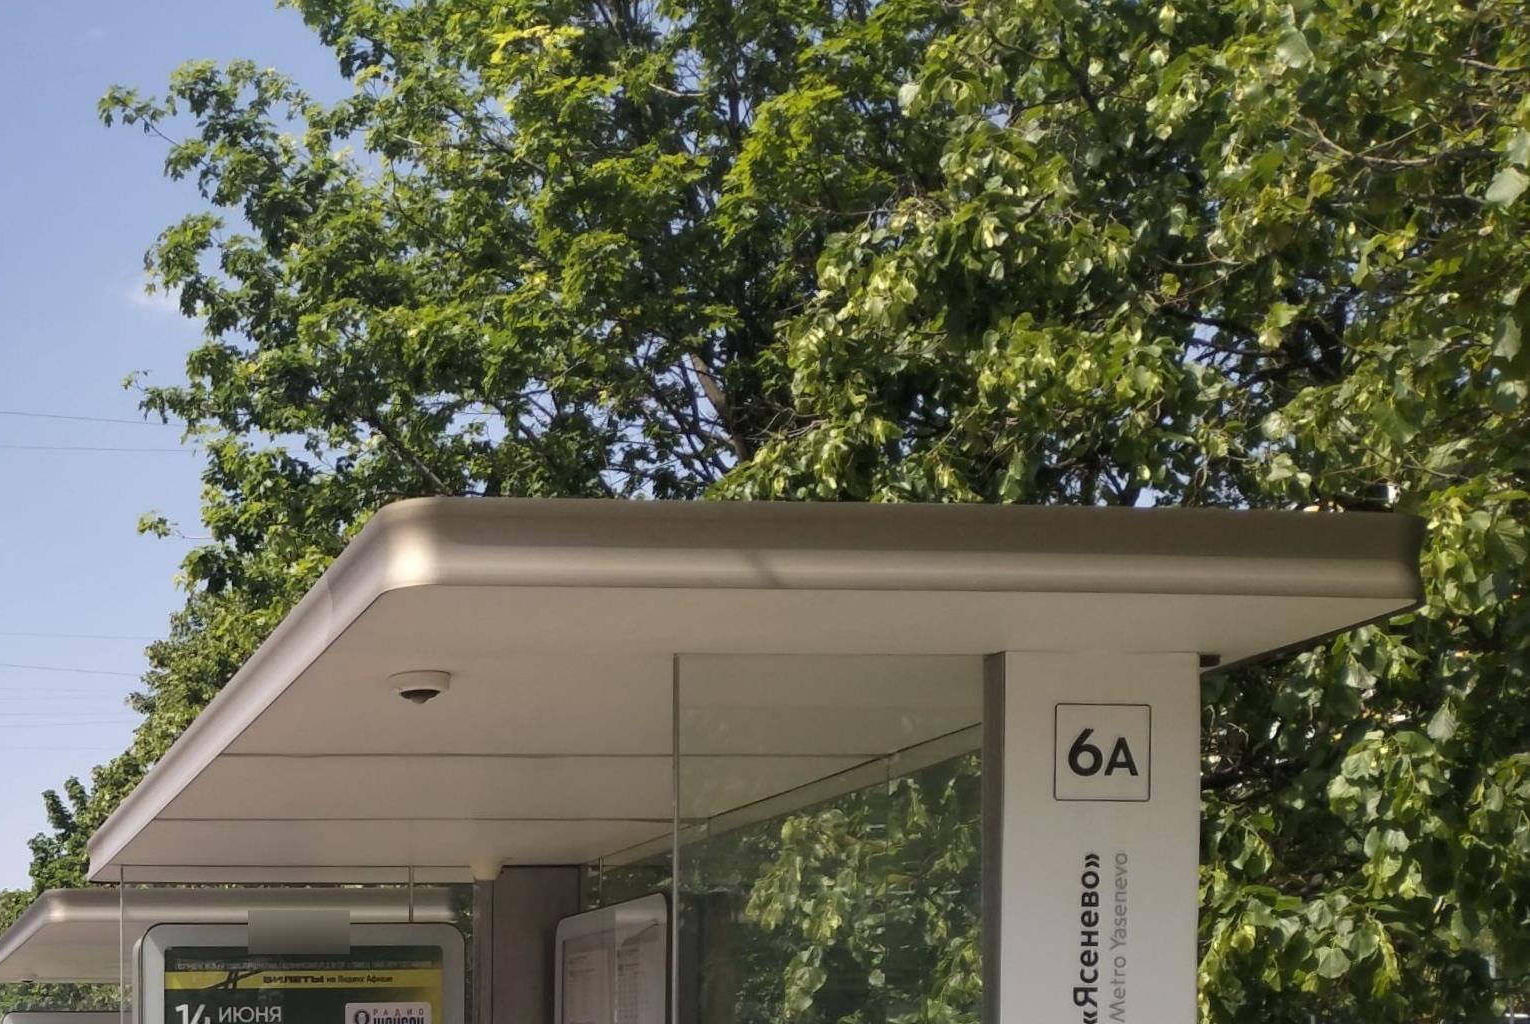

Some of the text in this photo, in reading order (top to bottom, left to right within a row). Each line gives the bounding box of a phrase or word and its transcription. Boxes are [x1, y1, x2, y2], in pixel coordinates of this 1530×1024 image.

[1067, 727, 1139, 777] 6А
[1109, 851, 1130, 1024] Metro Yasenevo
[262, 975, 325, 984] БИЛЕТЫ
[218, 1006, 282, 1024] ИЮНЯ
[373, 1008, 424, 1016] РАДИО
